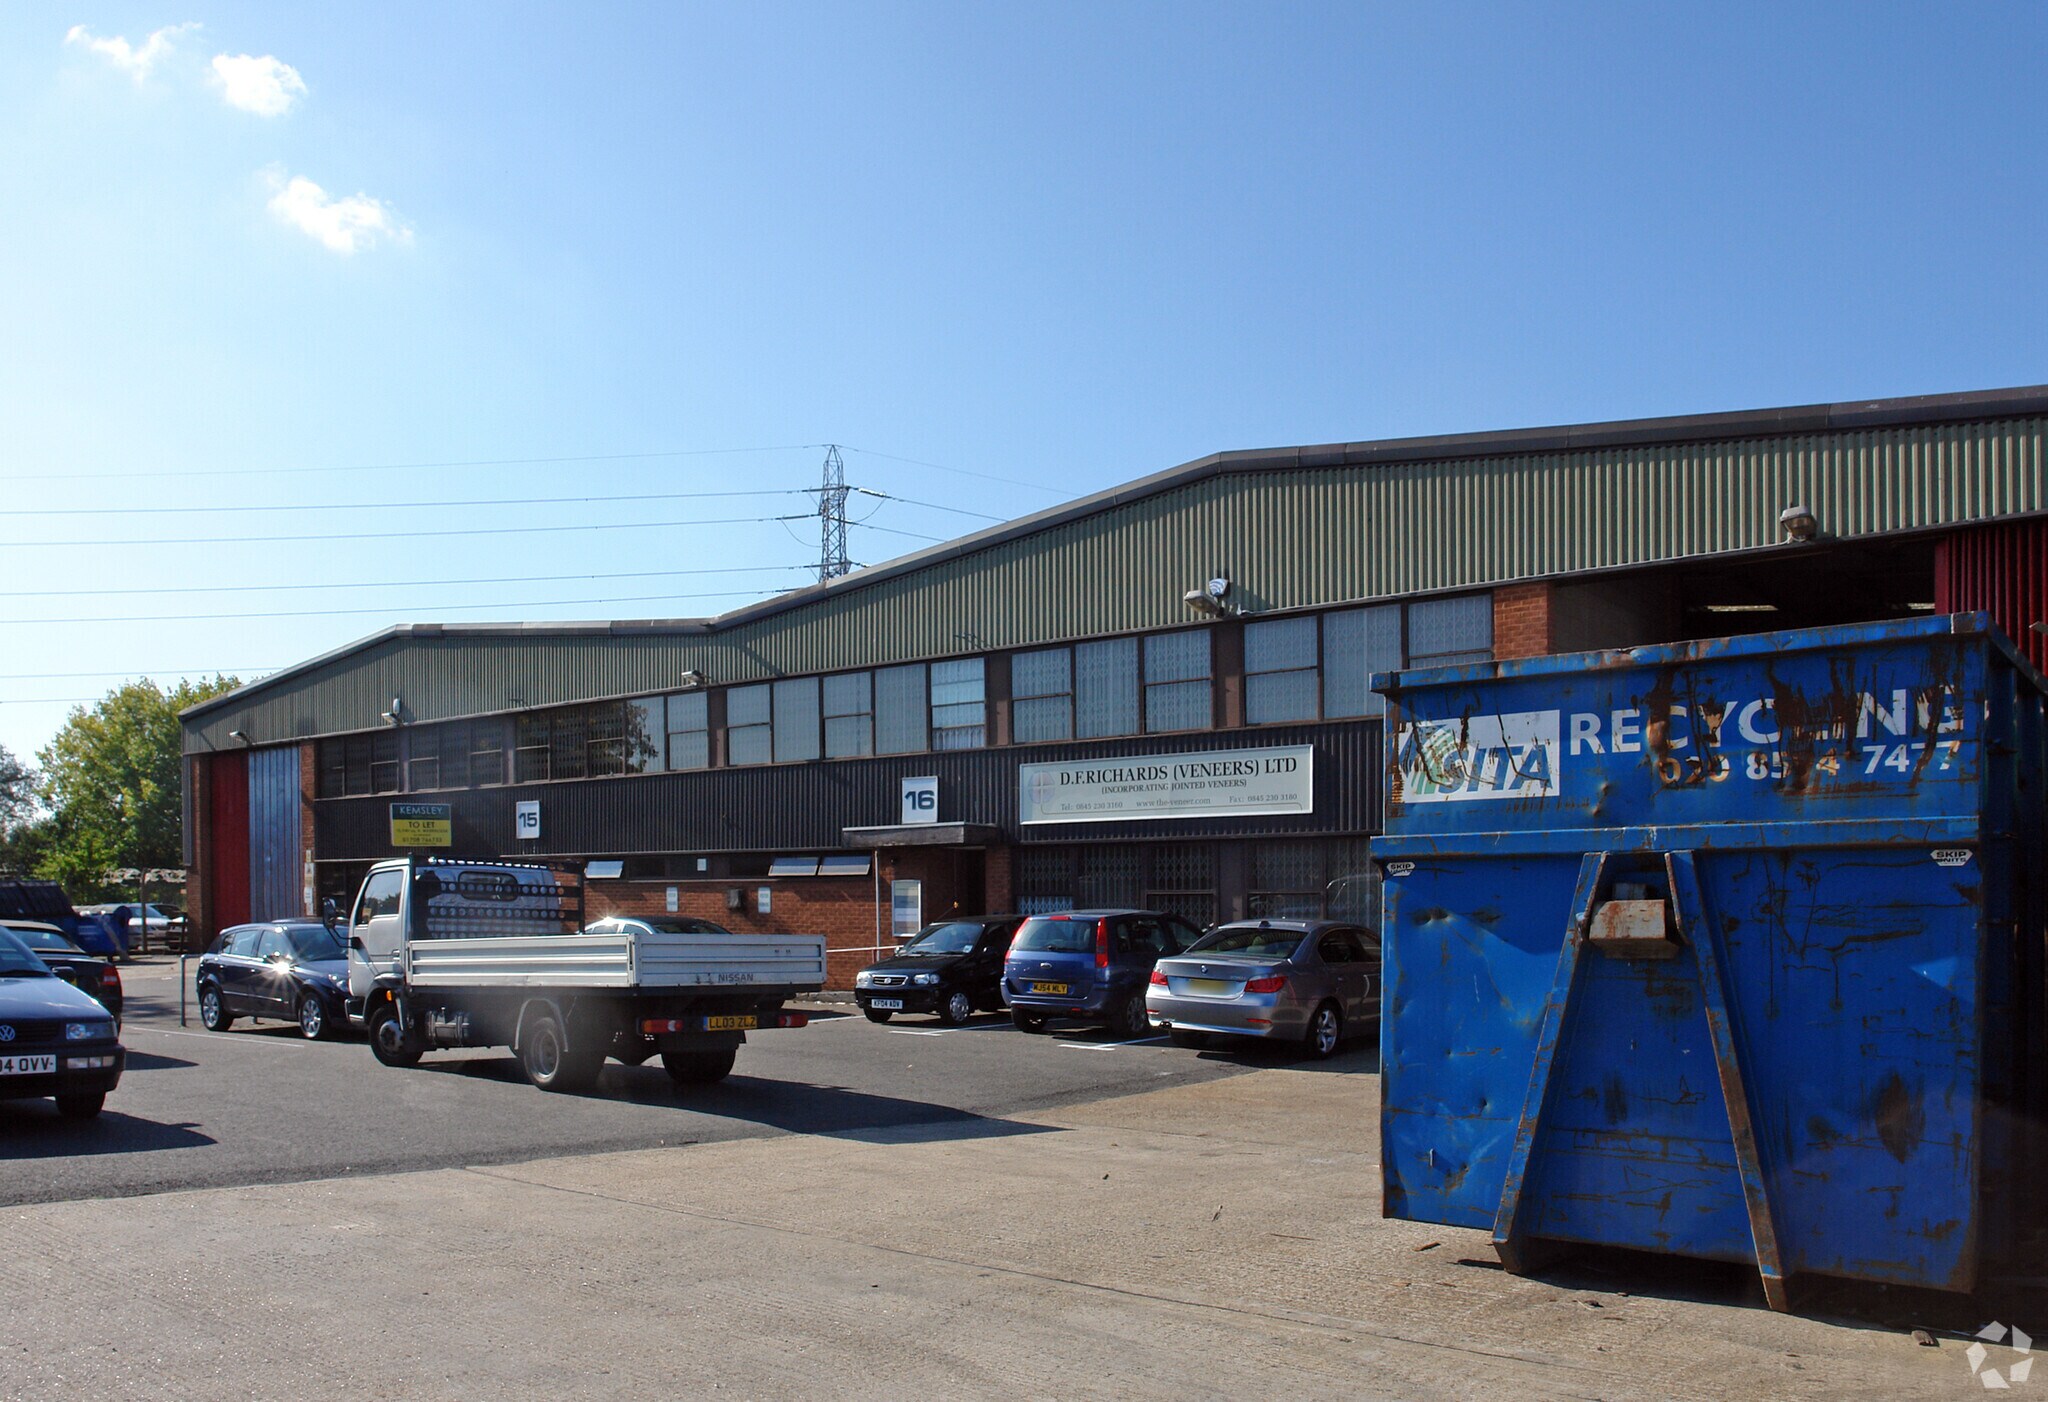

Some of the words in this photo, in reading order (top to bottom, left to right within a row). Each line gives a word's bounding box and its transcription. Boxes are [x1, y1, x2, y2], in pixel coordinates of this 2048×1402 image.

[1570, 684, 1964, 756] RECYCNG
[1060, 765, 1168, 786] D.F.RICHARDS
[1173, 759, 1260, 780] (VENEERS)
[1264, 757, 1297, 774] LTD
[1438, 744, 1553, 795] SITA
[1101, 782, 1169, 795] (INCORPORATING
[1171, 780, 1206, 791] JOINTED
[1208, 778, 1247, 789] VENEERS)
[904, 790, 935, 811] 16
[400, 806, 443, 815] KEMSLEY
[408, 821, 420, 829] TO
[422, 821, 435, 829] LET
[518, 812, 538, 828] 15
[718, 973, 754, 983] NISSAN
[709, 1017, 735, 1029] LL03
